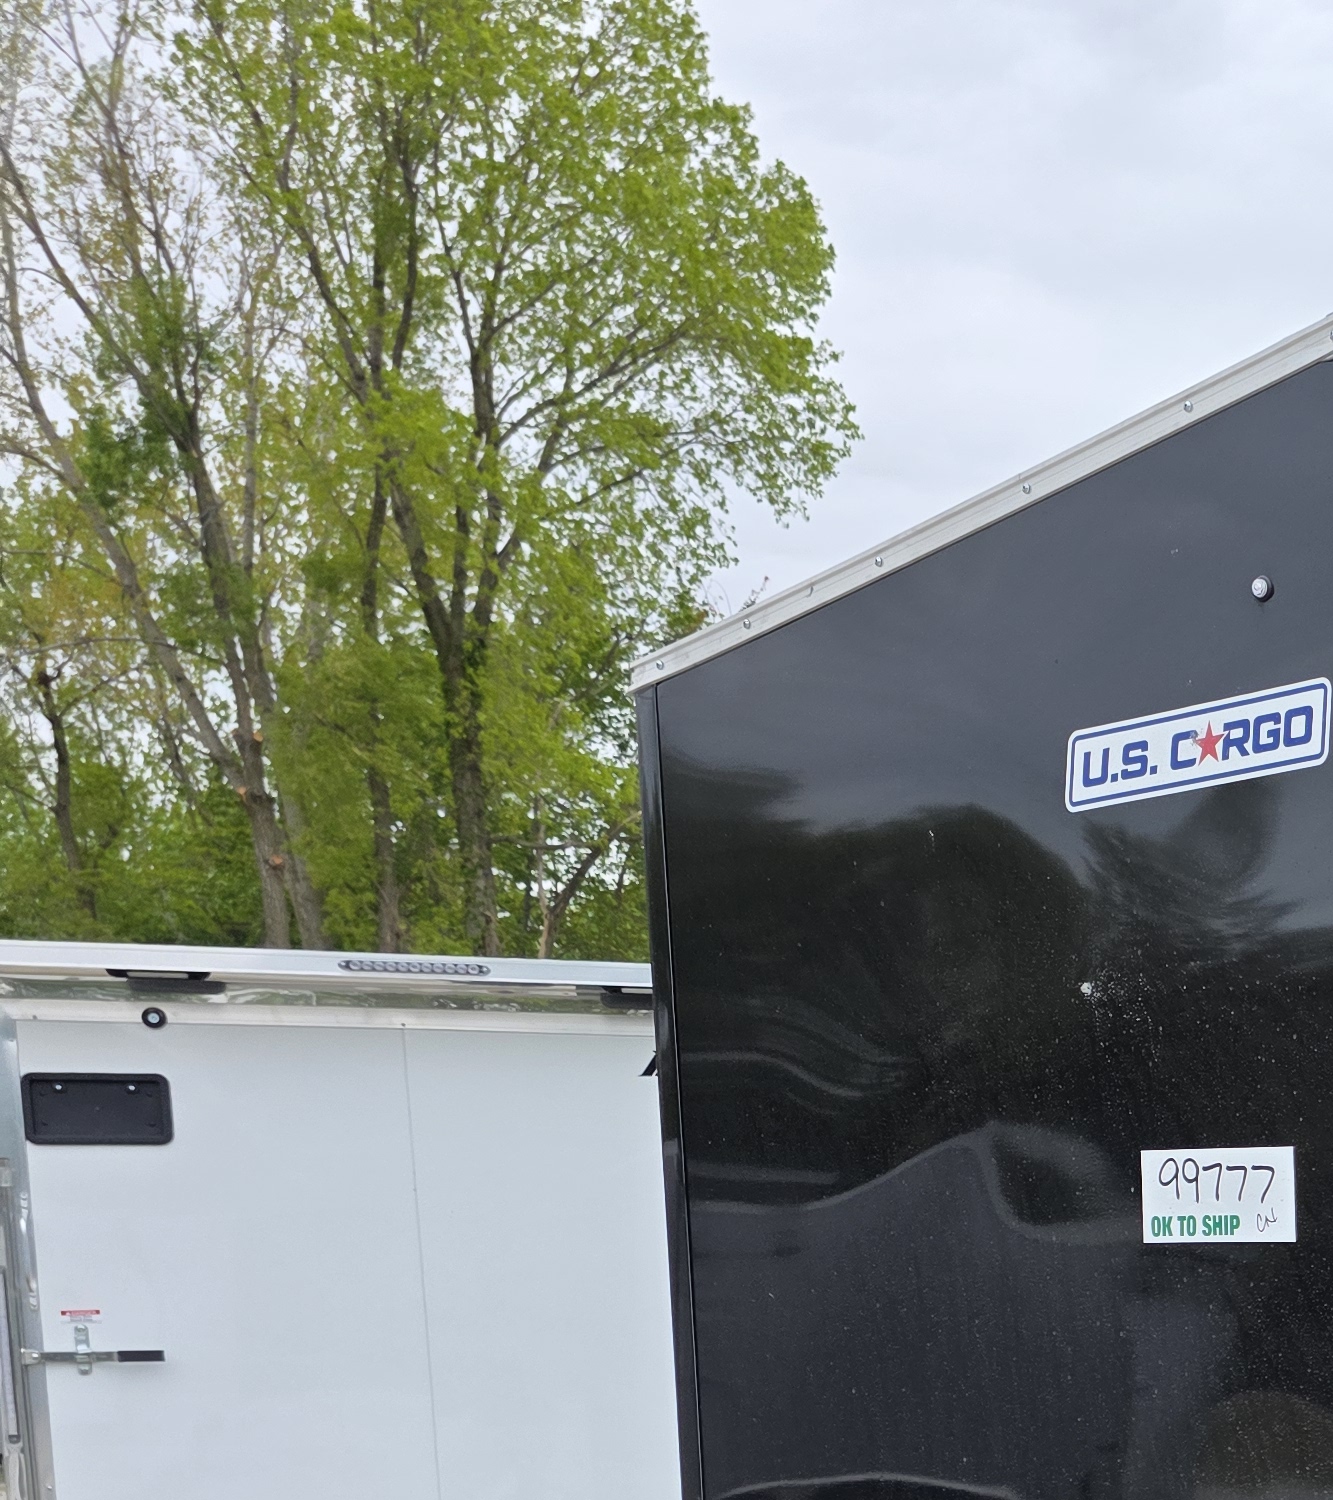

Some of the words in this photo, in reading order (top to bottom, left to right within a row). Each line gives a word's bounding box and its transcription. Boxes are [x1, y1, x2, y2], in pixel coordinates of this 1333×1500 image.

[1082, 740, 1158, 788] U.S.
[1158, 1157, 1275, 1204] 99777
[1150, 1215, 1173, 1237] OK
[1177, 1215, 1197, 1236] TO
[1202, 1214, 1240, 1236] SHIP
